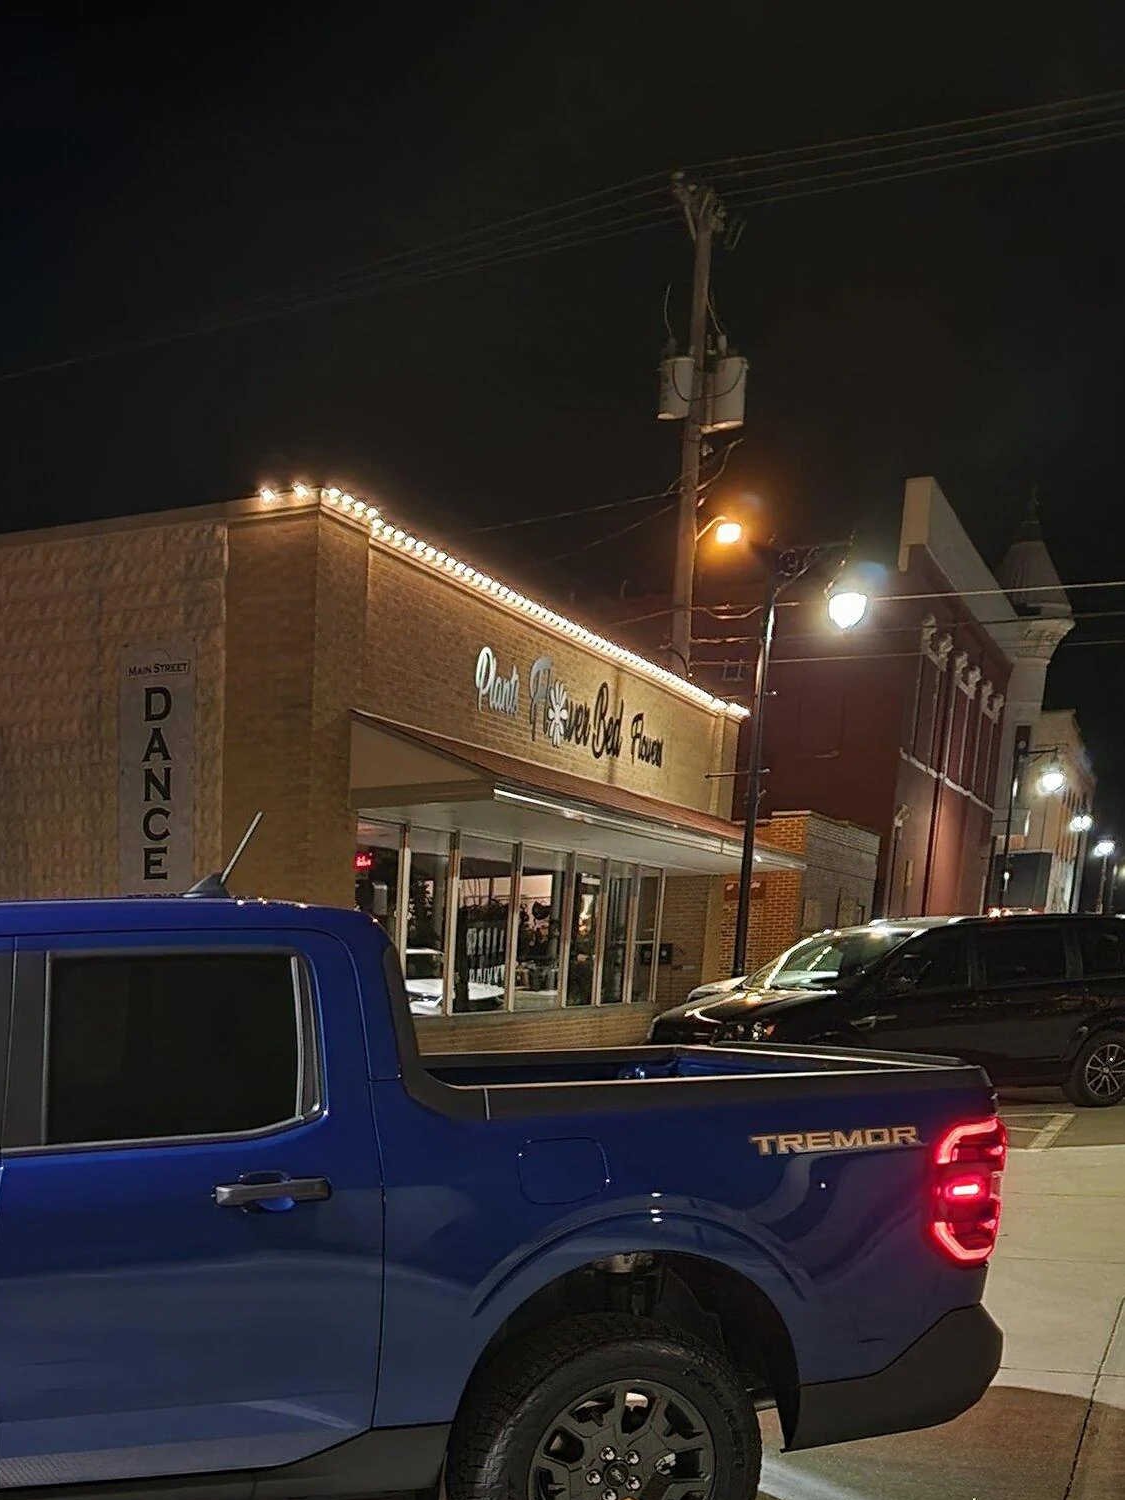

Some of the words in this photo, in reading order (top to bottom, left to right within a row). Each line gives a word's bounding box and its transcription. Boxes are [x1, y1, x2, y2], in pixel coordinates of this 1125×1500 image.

[154, 663, 188, 674] STREET
[592, 681, 623, 759] Bed
[142, 686, 172, 880] DANCE
[748, 1126, 923, 1155] TREMOR
